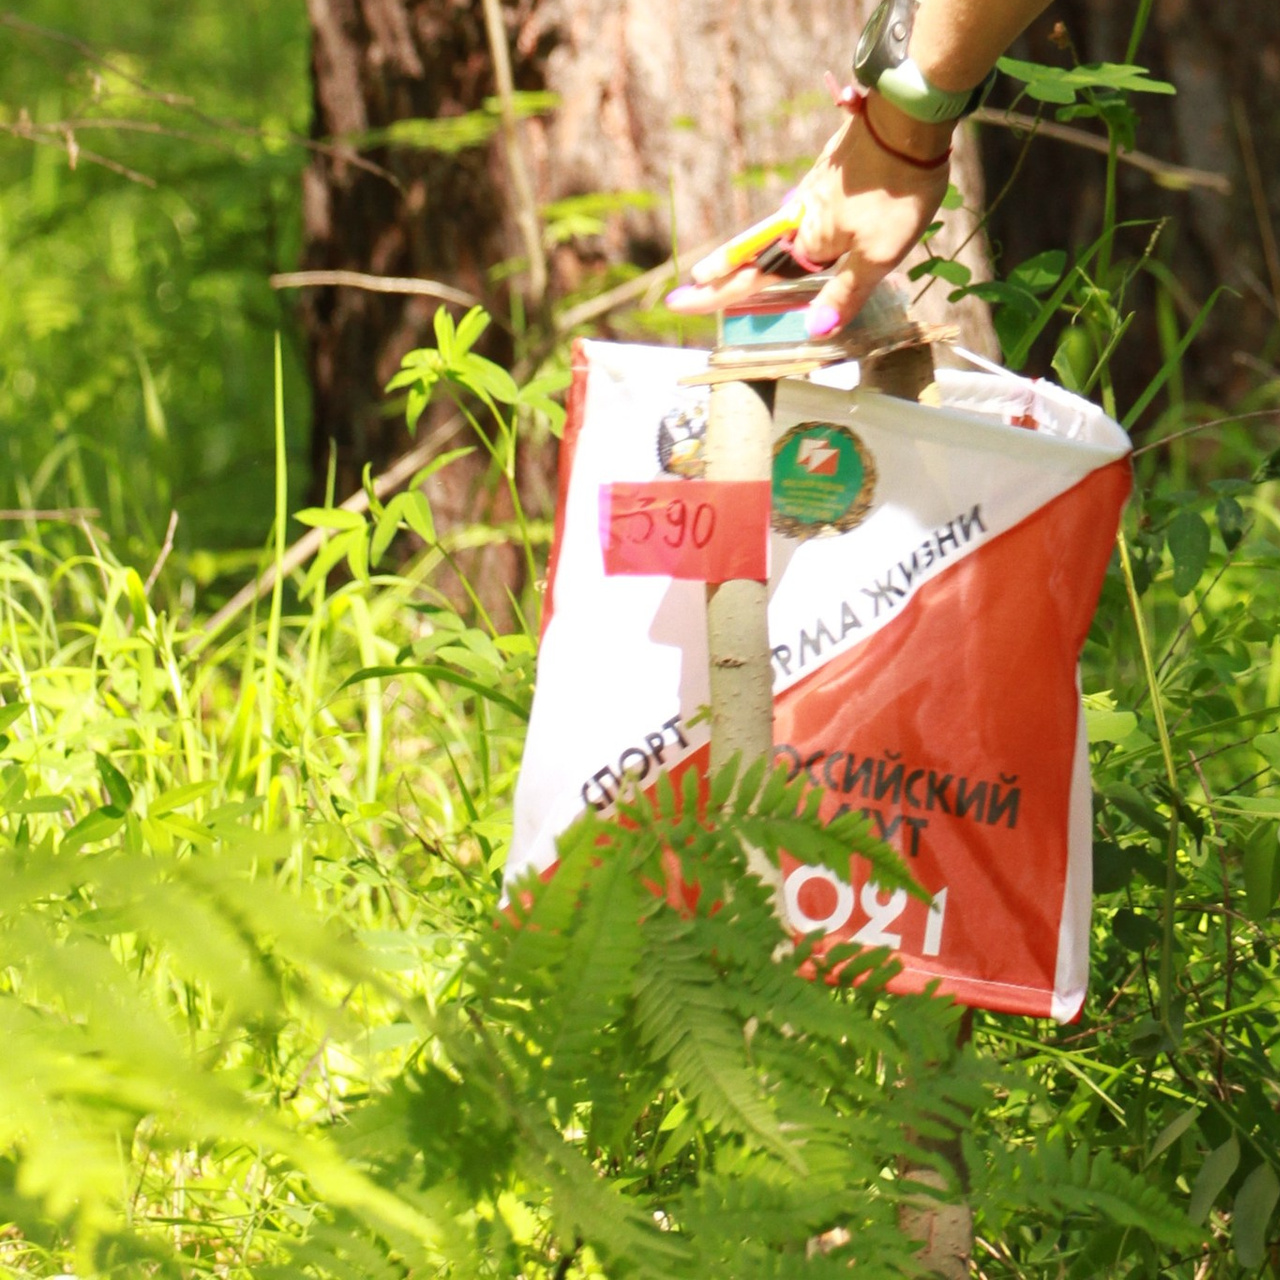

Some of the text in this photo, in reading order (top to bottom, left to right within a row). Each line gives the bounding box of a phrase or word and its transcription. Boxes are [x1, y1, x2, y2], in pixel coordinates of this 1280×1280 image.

[581, 714, 689, 812] СПОРТ
[860, 503, 988, 617] ЖИЗНИ
[773, 743, 1021, 829] ОССИЙСКИЙ
[783, 863, 948, 956] 021
